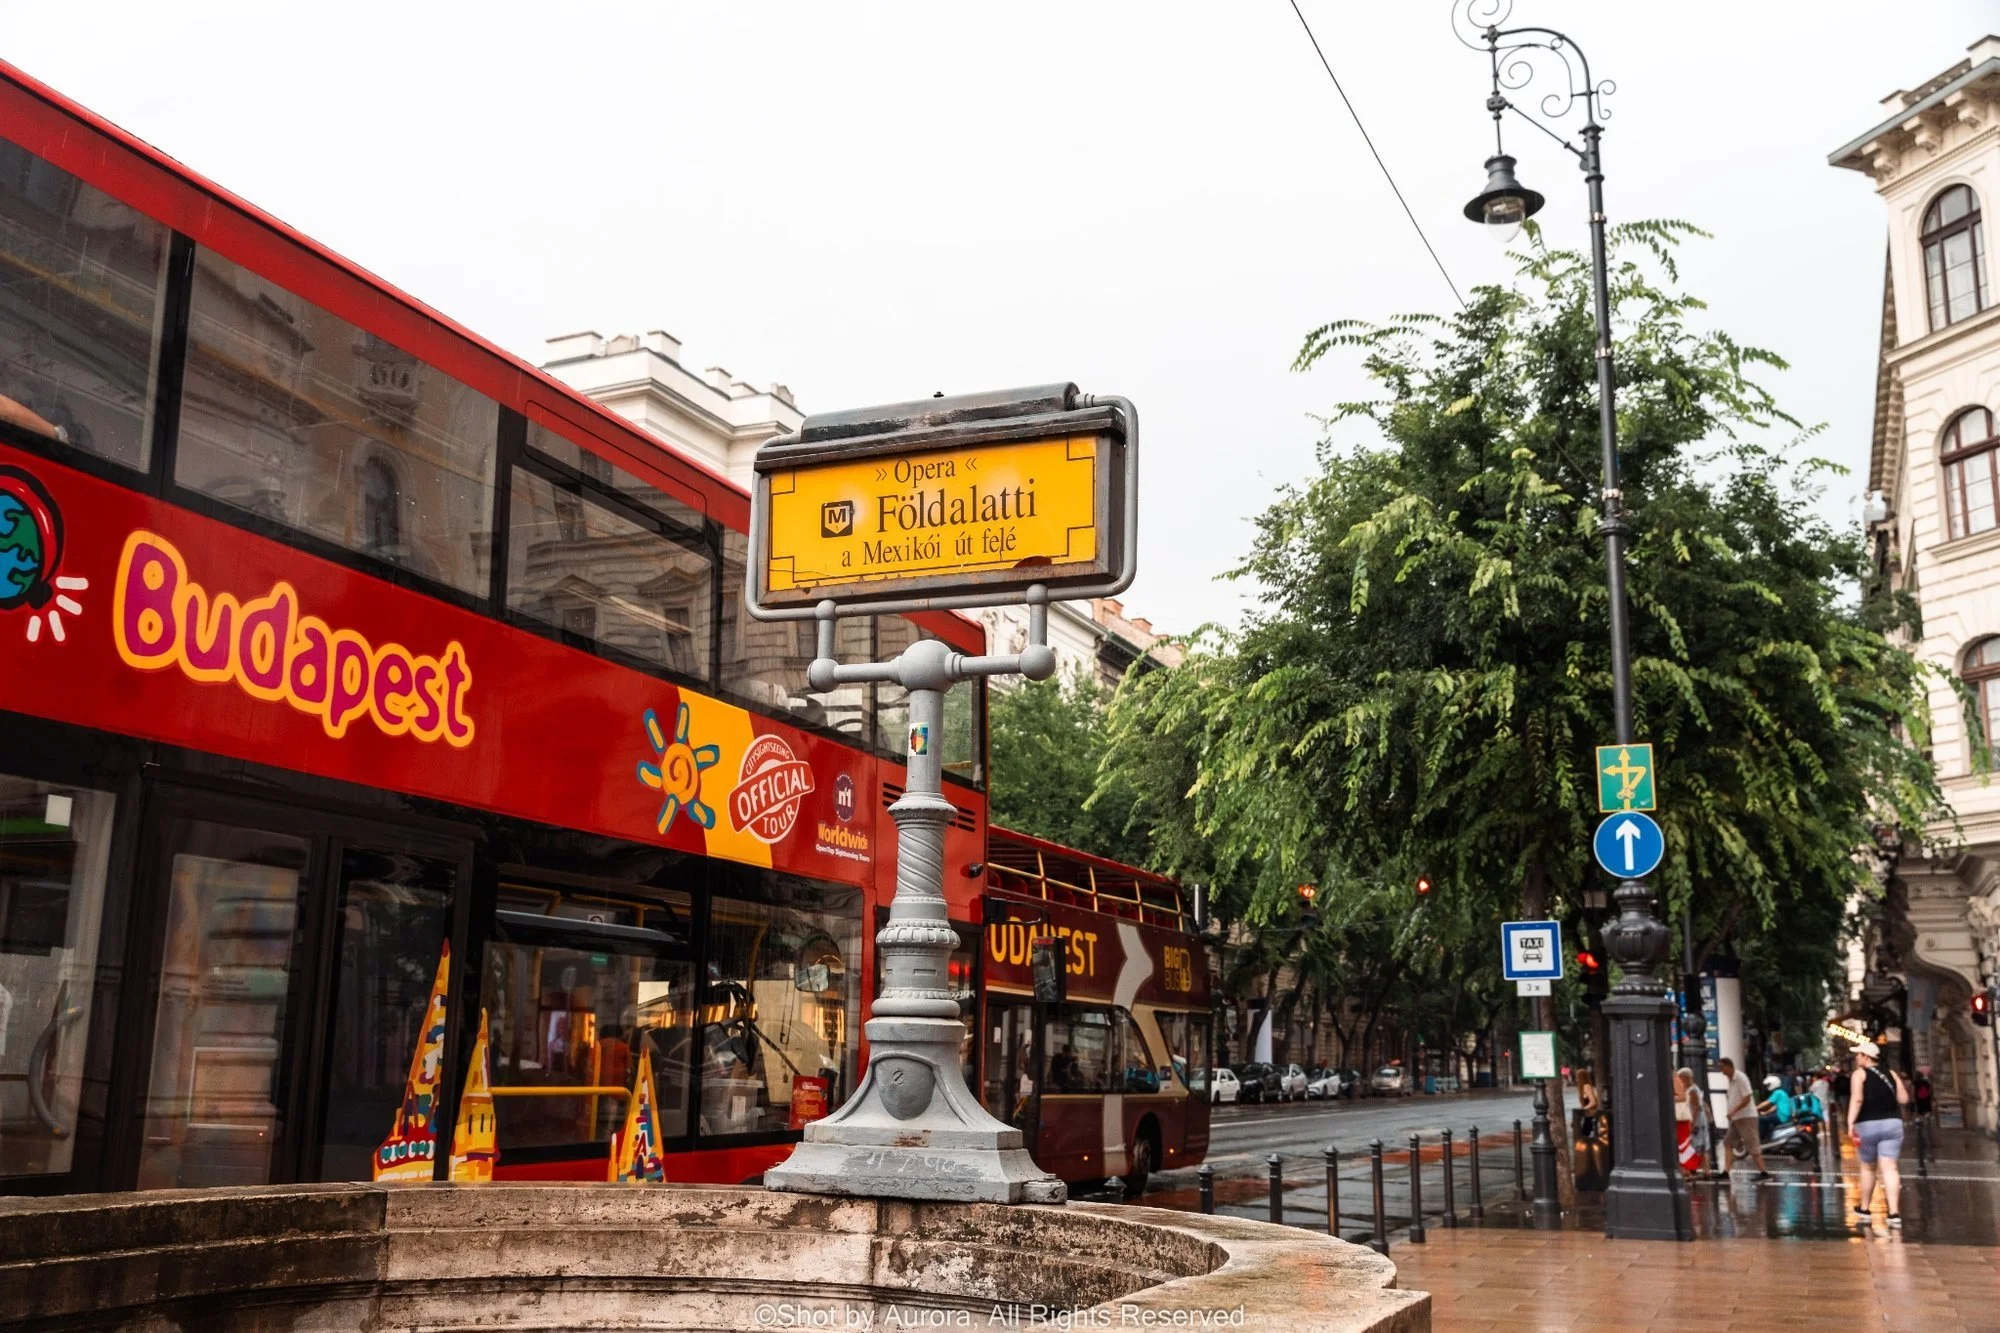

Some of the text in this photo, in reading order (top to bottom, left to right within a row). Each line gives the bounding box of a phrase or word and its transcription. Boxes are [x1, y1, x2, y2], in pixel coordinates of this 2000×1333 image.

[893, 457, 957, 488] Opera
[875, 477, 1038, 534] Földalatti
[841, 525, 1018, 568] a Mexikói út felé
[115, 530, 474, 747] Budapest
[737, 766, 810, 822] OFFICIAL
[763, 804, 795, 835] TOUR
[1164, 945, 1180, 969] BIG
[1519, 937, 1545, 949] TAXI
